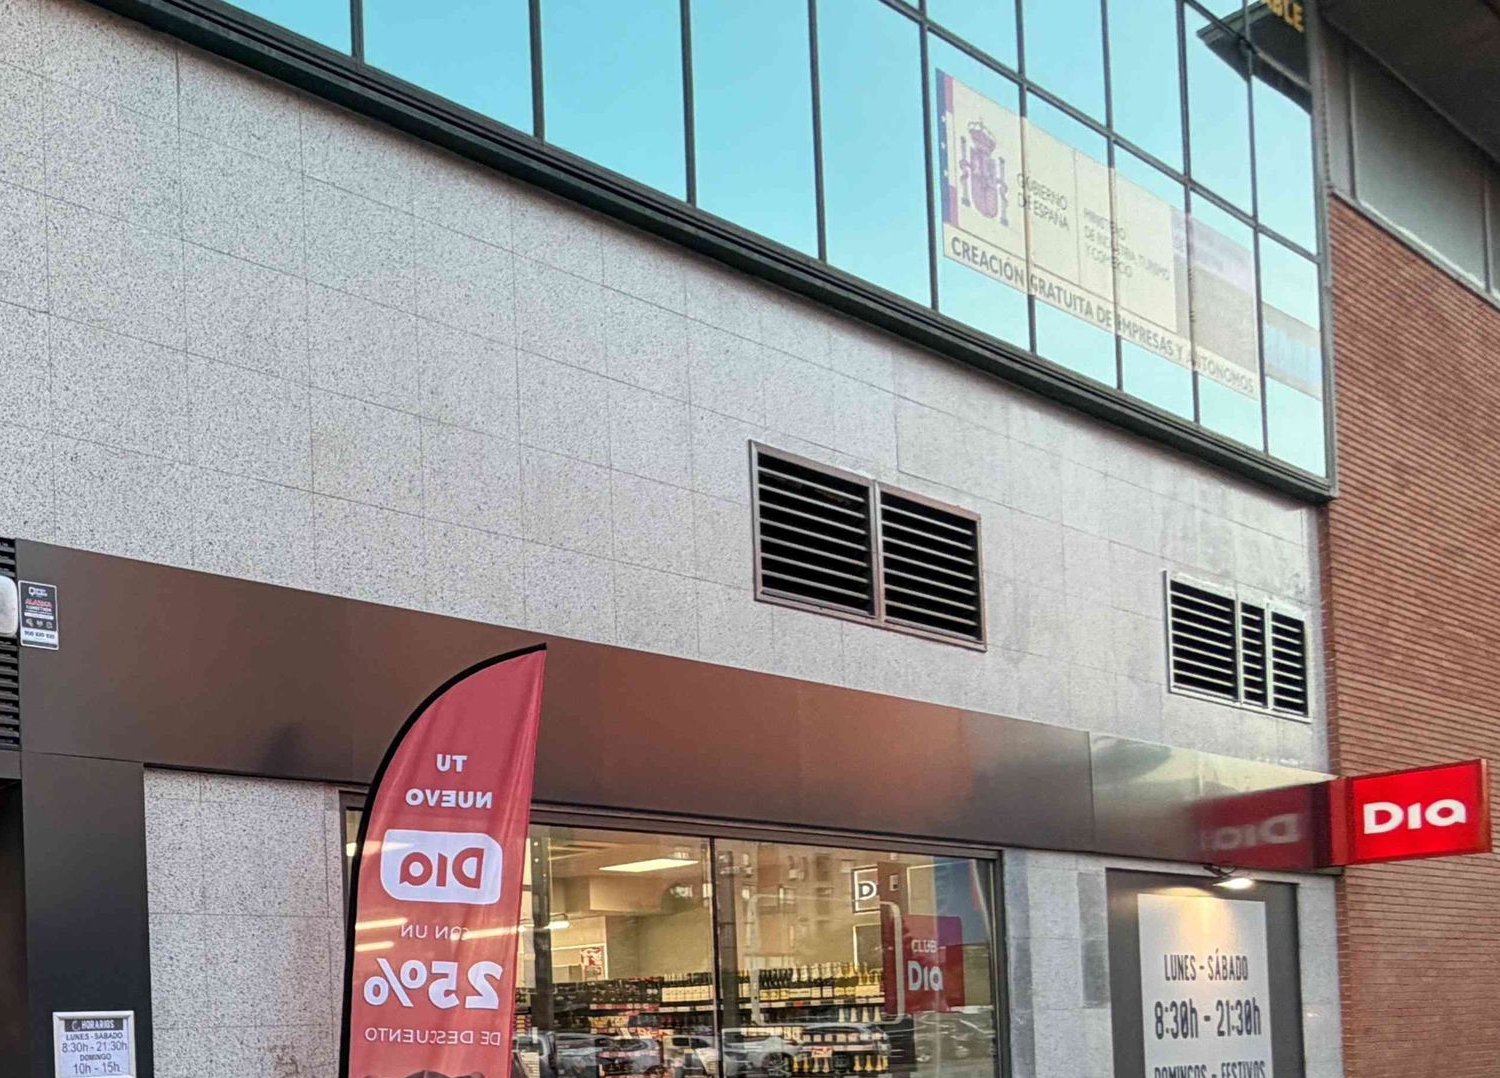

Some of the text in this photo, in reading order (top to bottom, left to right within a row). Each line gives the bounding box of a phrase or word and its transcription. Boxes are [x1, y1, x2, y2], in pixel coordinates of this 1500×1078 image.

[951, 237, 1025, 286] CREACIÓN
[1030, 274, 1095, 319] GRATUITA
[1096, 306, 1112, 327] DE
[1163, 954, 1197, 982] LUNES
[1207, 948, 1249, 981] SÁBADO
[1154, 1000, 1199, 1040] 8:30h
[1216, 997, 1262, 1037] 21:30h
[62, 1042, 88, 1052] 8:30h
[96, 1041, 127, 1051] 21:30h
[80, 1053, 112, 1061] DOMINGO
[73, 1063, 92, 1074] 10h
[102, 1062, 120, 1072] 15h
